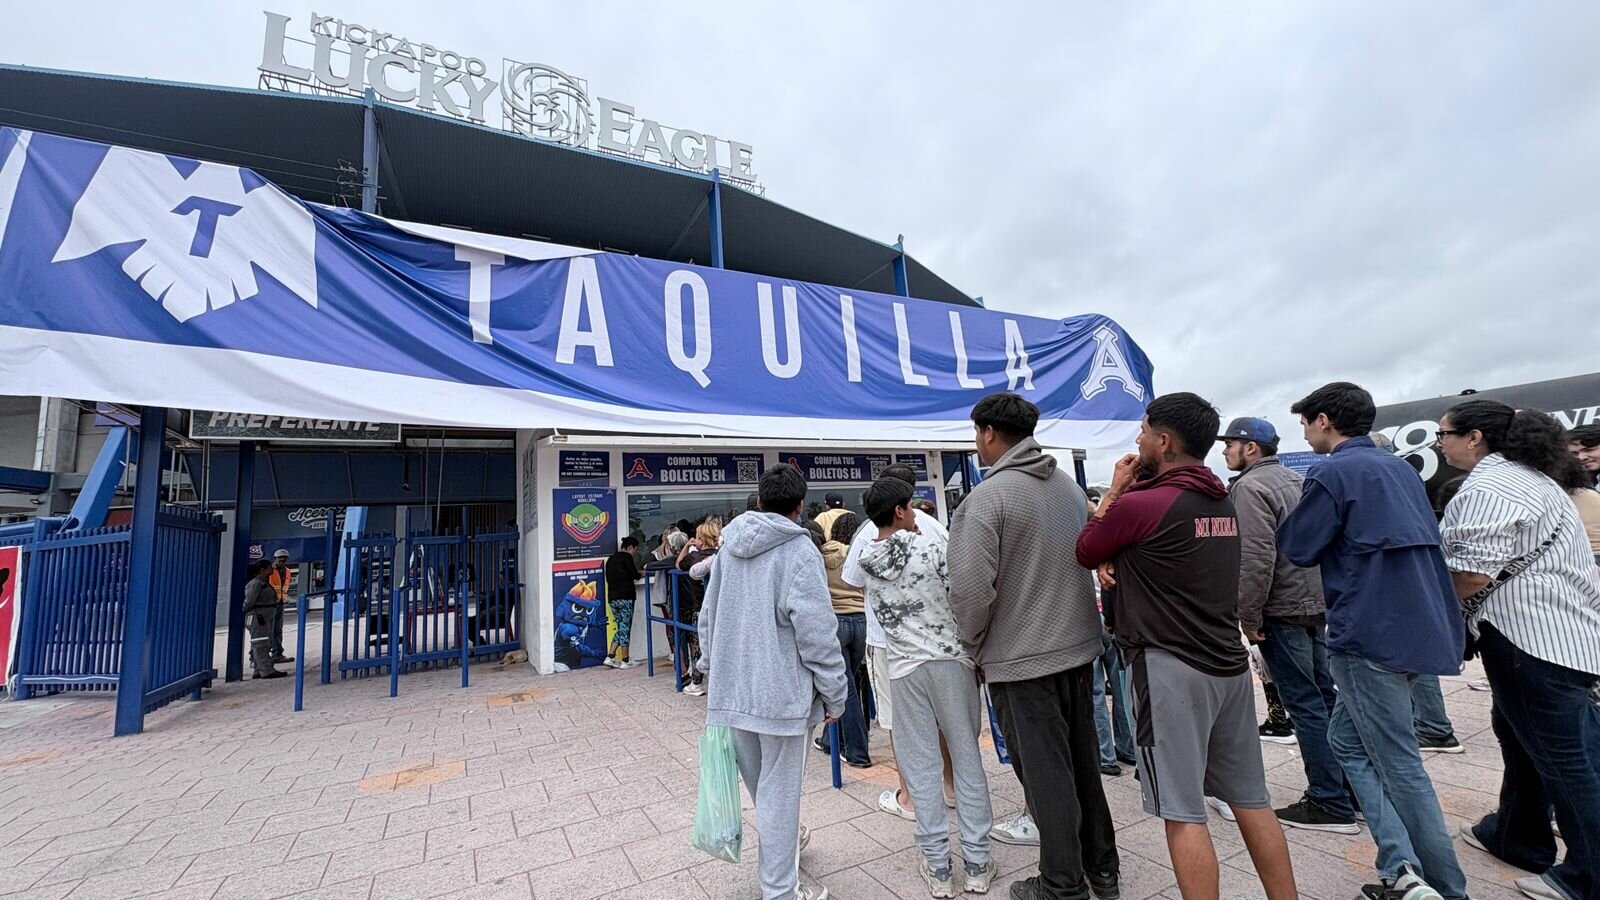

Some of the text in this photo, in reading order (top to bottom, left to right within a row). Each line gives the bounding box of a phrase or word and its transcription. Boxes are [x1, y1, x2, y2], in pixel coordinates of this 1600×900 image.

[309, 12, 487, 76] KICKAPOO
[257, 10, 758, 182] LUCKY EAGLE
[454, 243, 1036, 391] TAQUILLA
[667, 456, 718, 466] COMPRA TUS
[814, 456, 841, 465] COMPRA
[842, 456, 855, 465] TUS
[660, 469, 726, 482] BOLETOS EN
[809, 467, 862, 479] BOLETOS EN
[1194, 517, 1210, 538] MI
[1503, 544, 1546, 575] BIMBA
